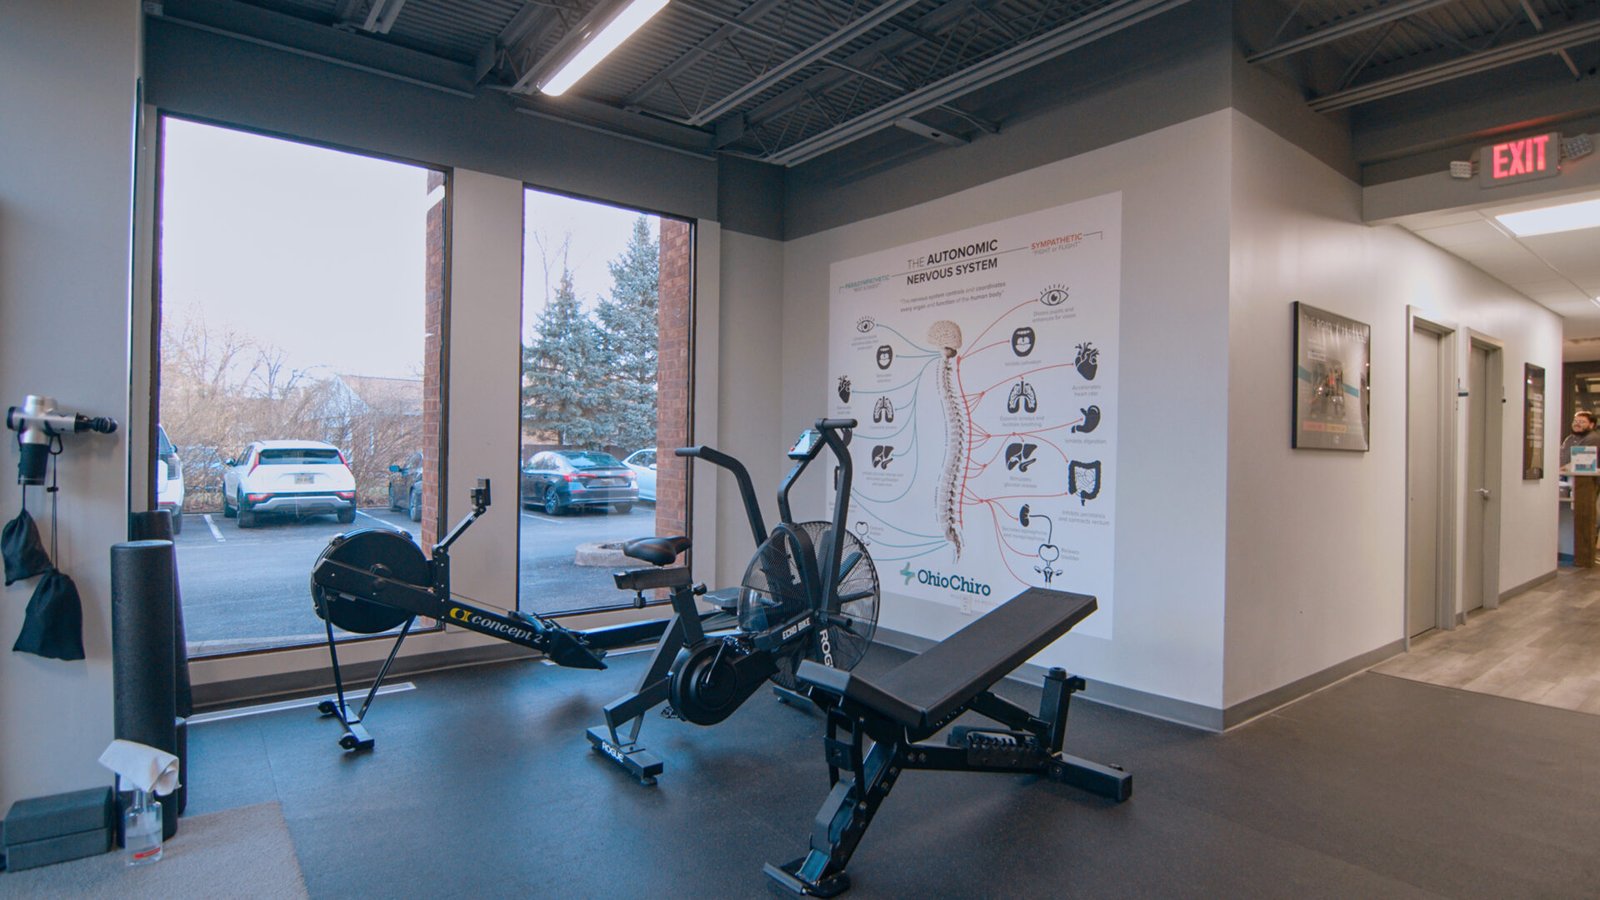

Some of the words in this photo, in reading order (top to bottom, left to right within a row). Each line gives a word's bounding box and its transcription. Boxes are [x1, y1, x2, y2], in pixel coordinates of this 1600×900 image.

[1493, 135, 1549, 179] EXIT
[908, 257, 926, 270] THE
[927, 239, 999, 266] AUTONOMIC
[1032, 233, 1082, 249] SYMPATHETIC
[907, 267, 953, 286] NERVOUS
[955, 257, 998, 276] SYSTEM
[918, 569, 991, 596] OhioChiro
[471, 615, 533, 640] concept
[782, 625, 797, 640] ECHO
[798, 617, 811, 631] BIKE
[819, 629, 834, 668] ROG
[602, 741, 625, 763] ROGUE
